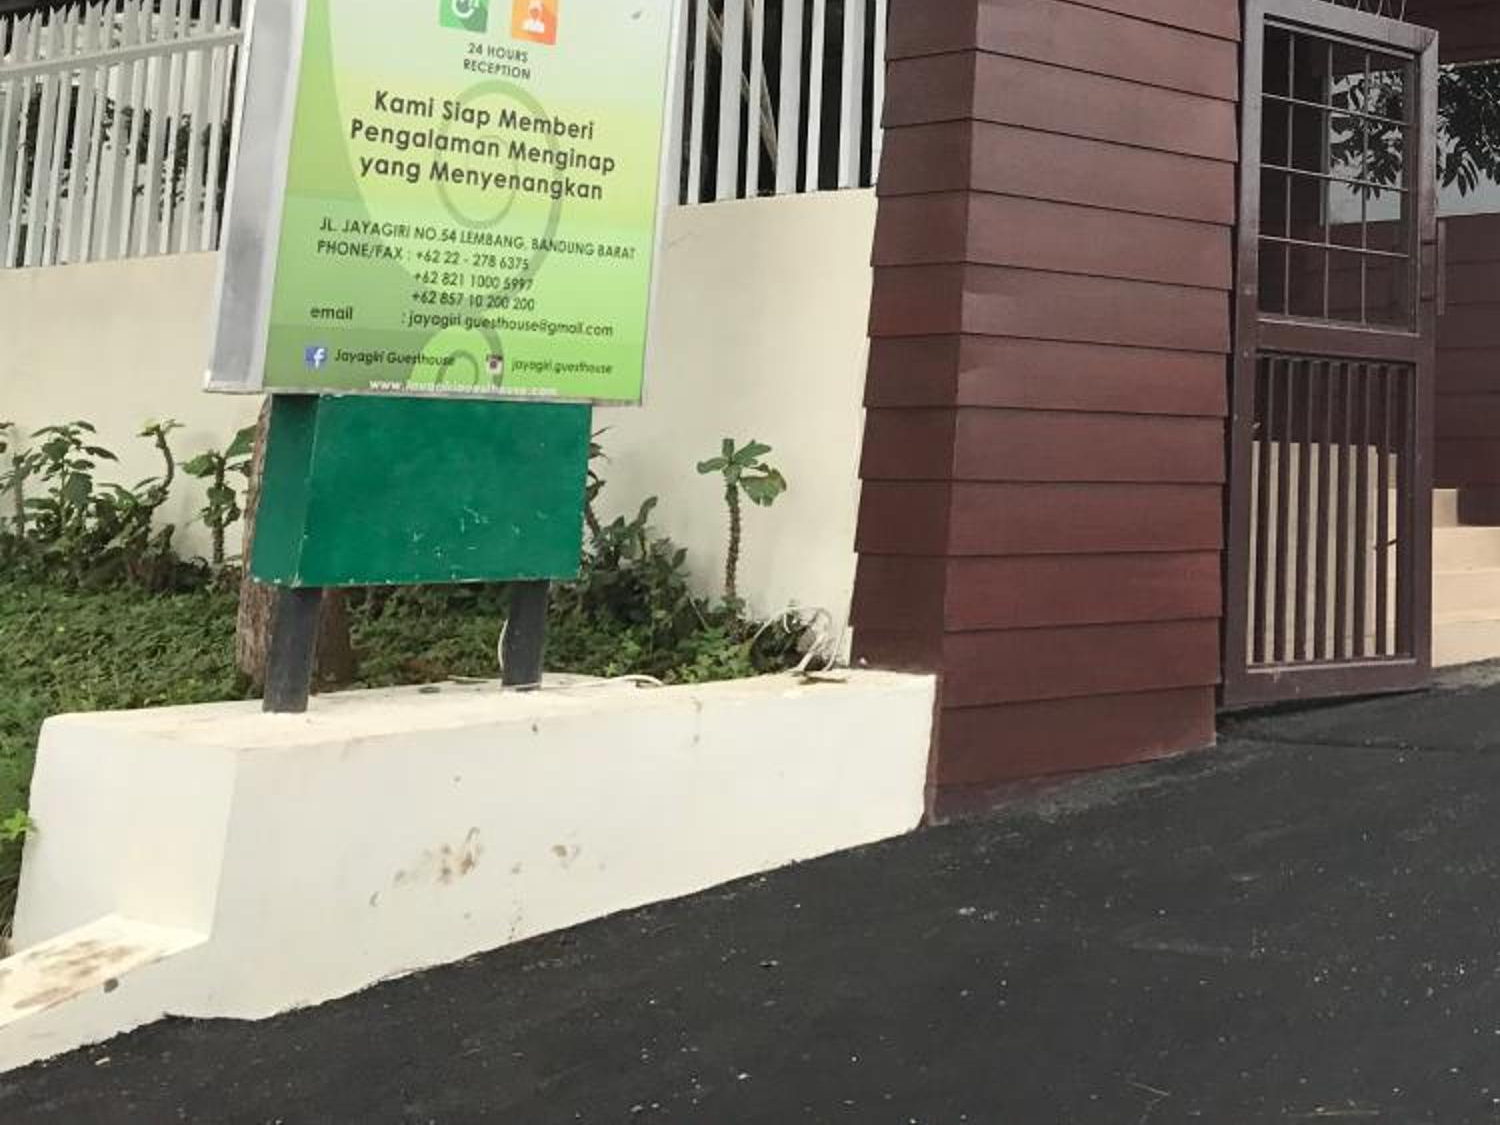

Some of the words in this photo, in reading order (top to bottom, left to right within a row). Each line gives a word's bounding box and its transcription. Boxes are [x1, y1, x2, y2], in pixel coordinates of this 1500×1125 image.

[467, 42, 483, 56] 24
[487, 46, 528, 63] HOURS
[463, 59, 531, 79] RECEPTION
[374, 90, 434, 118] Kami
[443, 100, 490, 128] Siap
[499, 108, 594, 140] Memberi
[351, 118, 500, 158] Pengalaman
[507, 140, 615, 175] Menginap
[360, 156, 421, 183] yang
[429, 160, 602, 200] Menyenangkan
[341, 219, 410, 238] JAYAGIRI
[531, 238, 595, 256] BANDUNG
[597, 243, 637, 260] BARAT
[316, 239, 403, 260] PHONE/FAX
[416, 250, 441, 264] +62
[443, 250, 461, 265] 22
[472, 253, 496, 268] 278
[499, 256, 529, 271] 6375
[414, 271, 438, 285] +62
[441, 272, 465, 286] 821
[470, 275, 500, 289] 1000
[412, 290, 437, 304] +62
[439, 292, 465, 305] 857
[468, 294, 483, 308] 10
[486, 295, 510, 309] 200
[513, 298, 536, 312] 200
[310, 306, 354, 320] email
[335, 348, 385, 366] Jayagiri
[387, 352, 455, 366] Guesthouse
